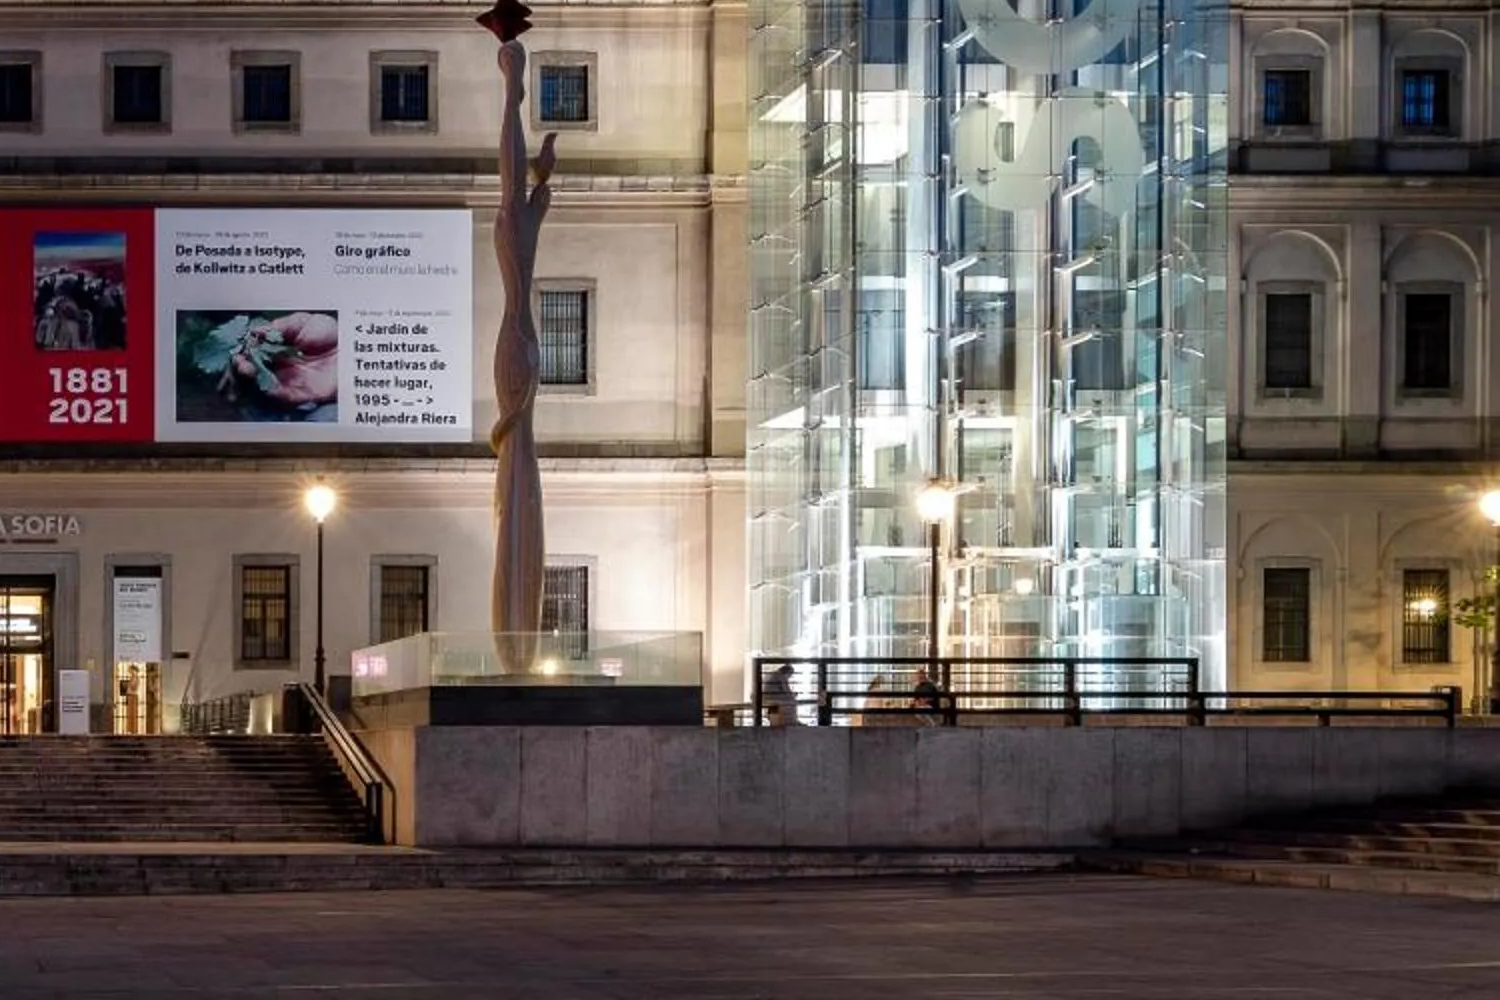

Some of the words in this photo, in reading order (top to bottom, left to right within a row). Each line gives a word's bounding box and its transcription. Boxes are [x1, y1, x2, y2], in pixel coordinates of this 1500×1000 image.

[175, 245, 193, 256] De
[195, 244, 242, 256] Posada
[244, 247, 252, 256] a
[255, 245, 305, 258] Isotype,
[335, 244, 363, 257] Giro
[365, 244, 411, 259] gráfico
[175, 262, 191, 274] de
[194, 262, 245, 274] Kollwitz
[248, 265, 256, 274] a
[258, 261, 304, 274] Catlett
[412, 323, 429, 335] de
[355, 340, 373, 352] las
[356, 358, 427, 370] Tentativas
[429, 358, 447, 370] de
[49, 367, 128, 394] 1881
[355, 375, 391, 388] hacer
[394, 375, 433, 391] lugar,
[356, 393, 391, 406] 1995
[49, 397, 128, 424] 2021
[355, 412, 418, 426] Alejandra
[421, 412, 457, 425] Riera
[11, 515, 81, 535] SOFIA
